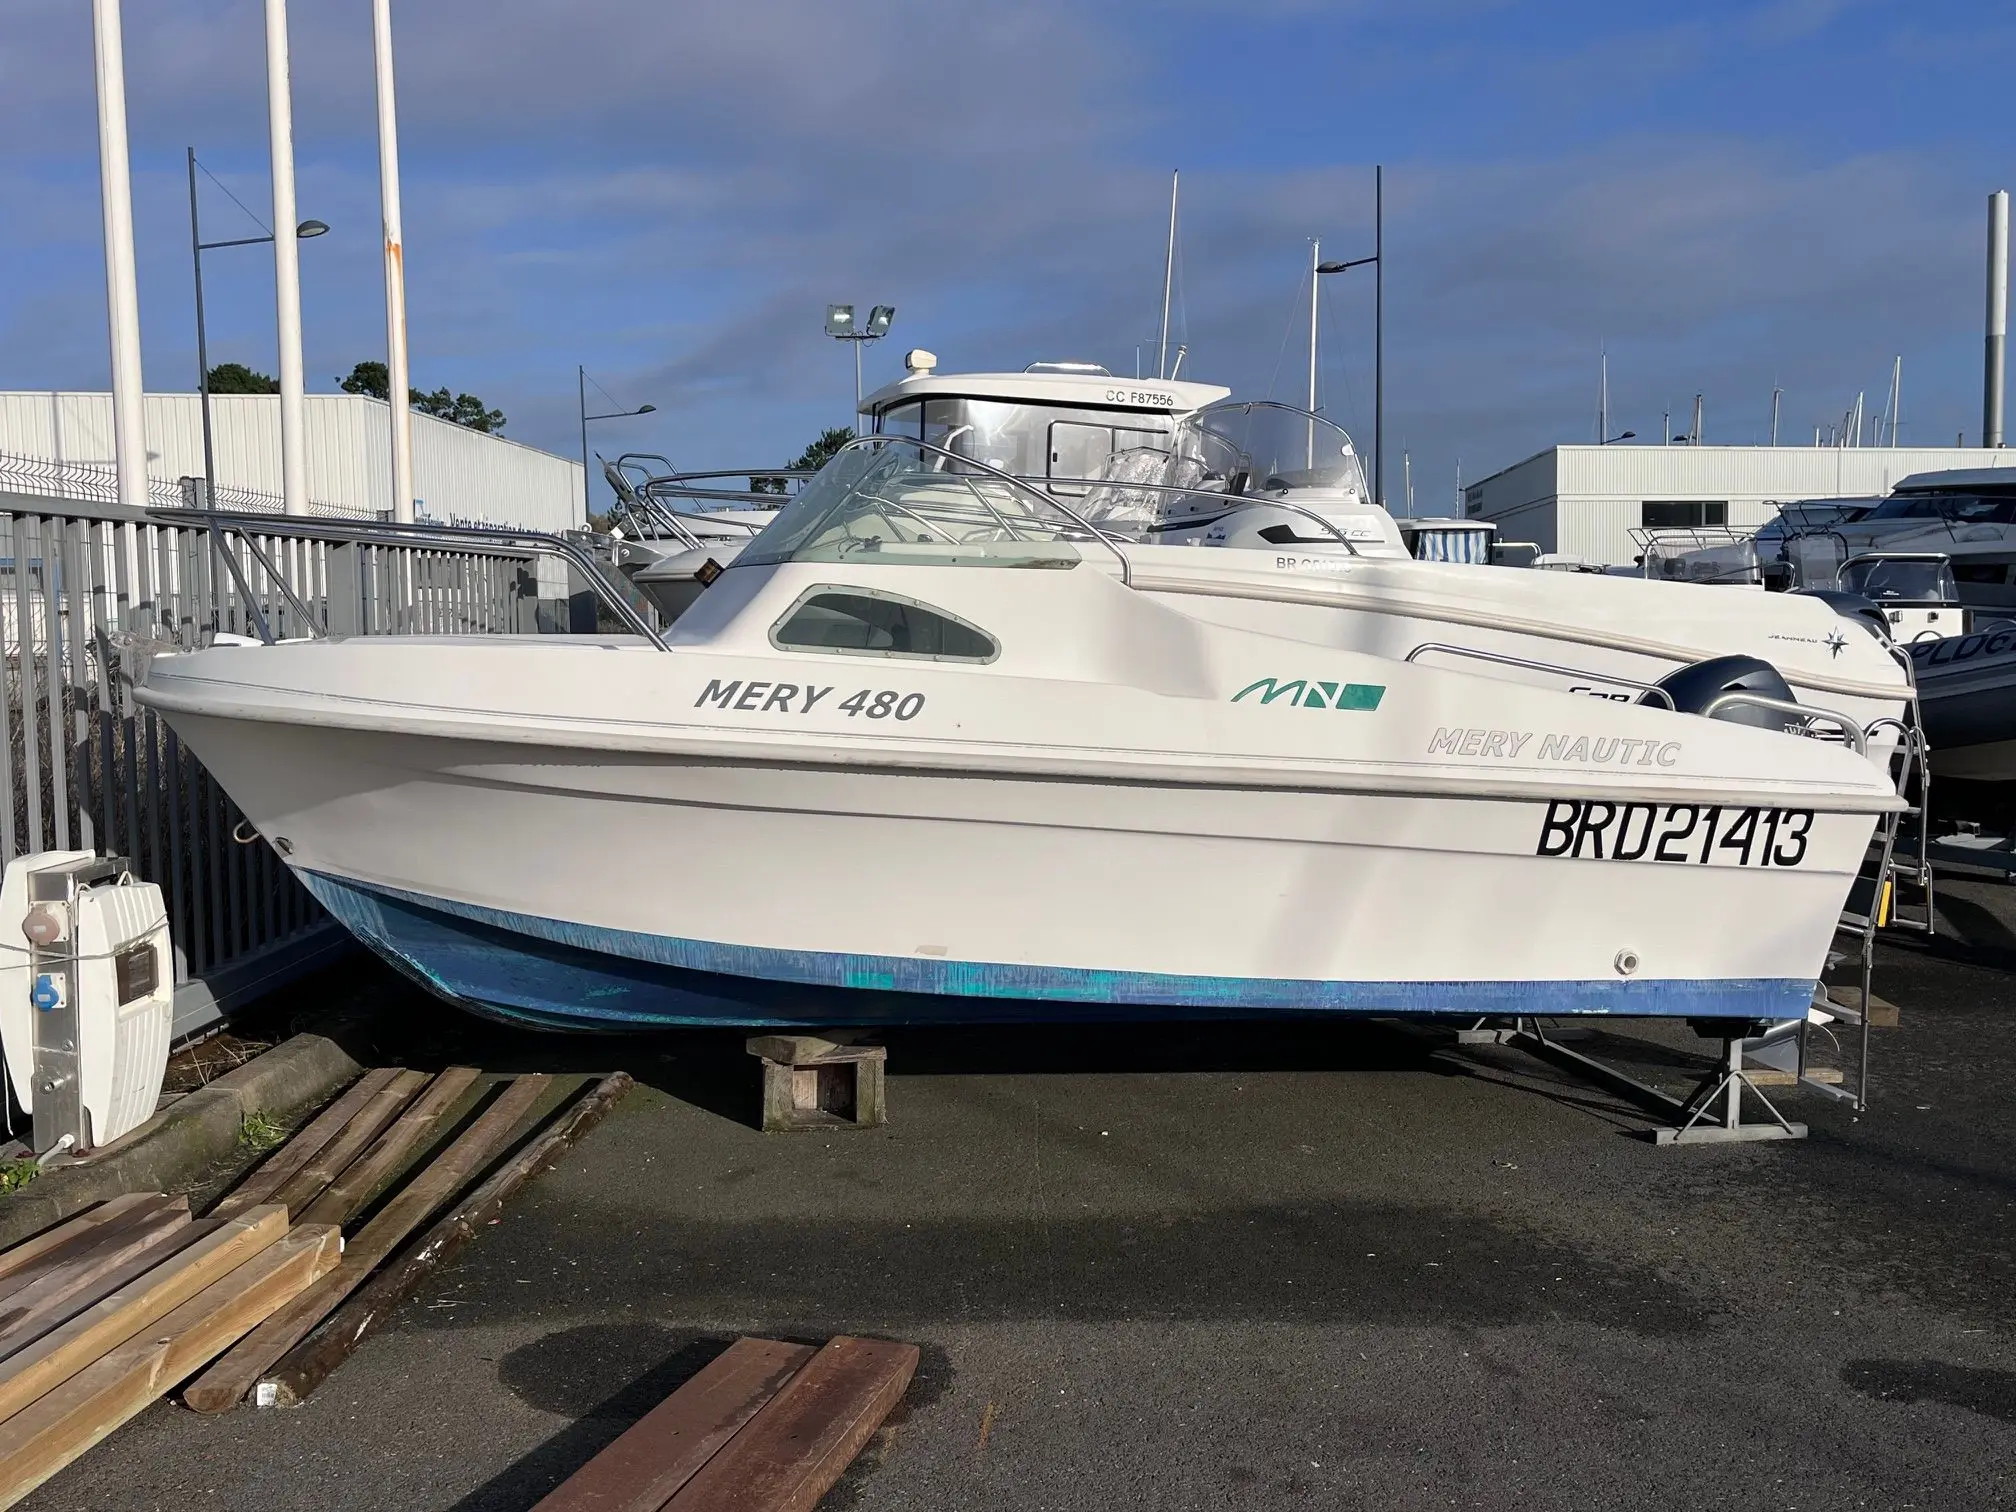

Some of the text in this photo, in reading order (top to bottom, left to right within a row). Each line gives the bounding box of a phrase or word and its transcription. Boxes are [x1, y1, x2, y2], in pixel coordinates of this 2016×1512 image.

[1106, 390, 1173, 406] CC F87556
[694, 679, 926, 721] MERY 480
[1428, 727, 1682, 766] MERY NAUTIC
[1536, 799, 1814, 867] BRD21413
